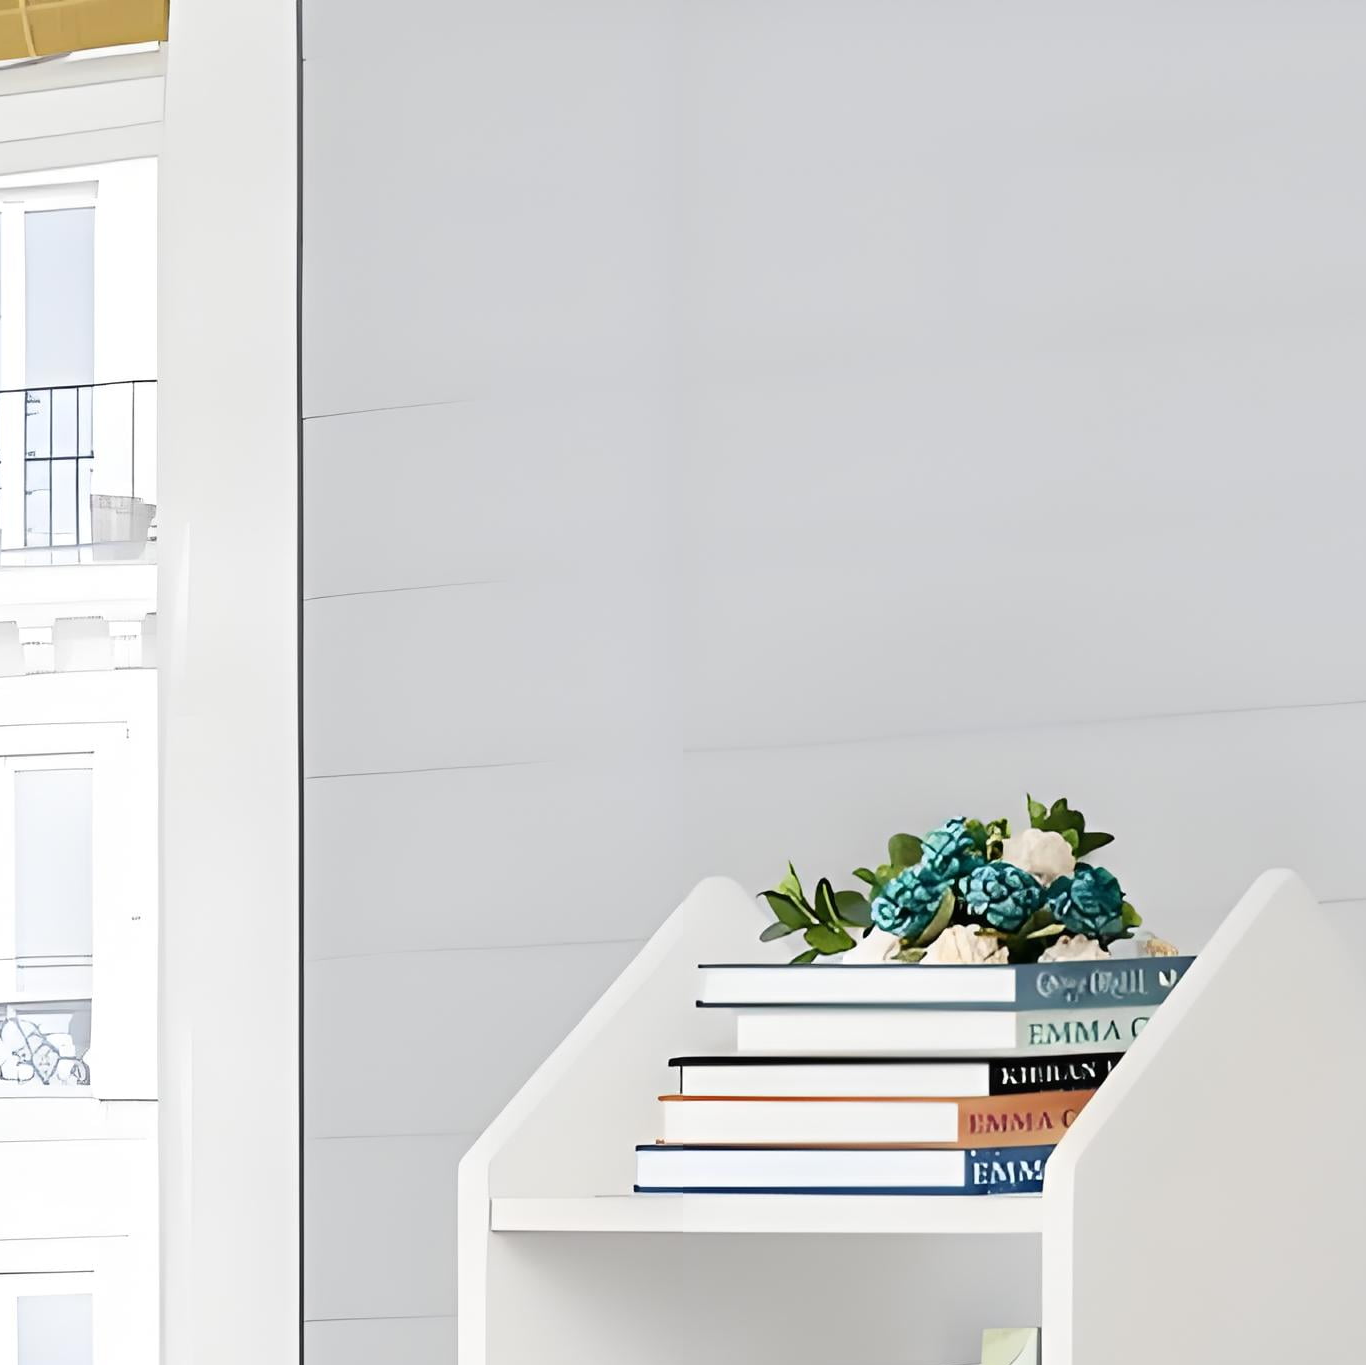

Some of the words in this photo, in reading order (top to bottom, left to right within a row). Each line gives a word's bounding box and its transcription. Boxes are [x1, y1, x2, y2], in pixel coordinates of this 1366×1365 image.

[1029, 1019, 1121, 1046] EMMA
[968, 1111, 1053, 1135] EMMA
[973, 1159, 1044, 1186] EMM
